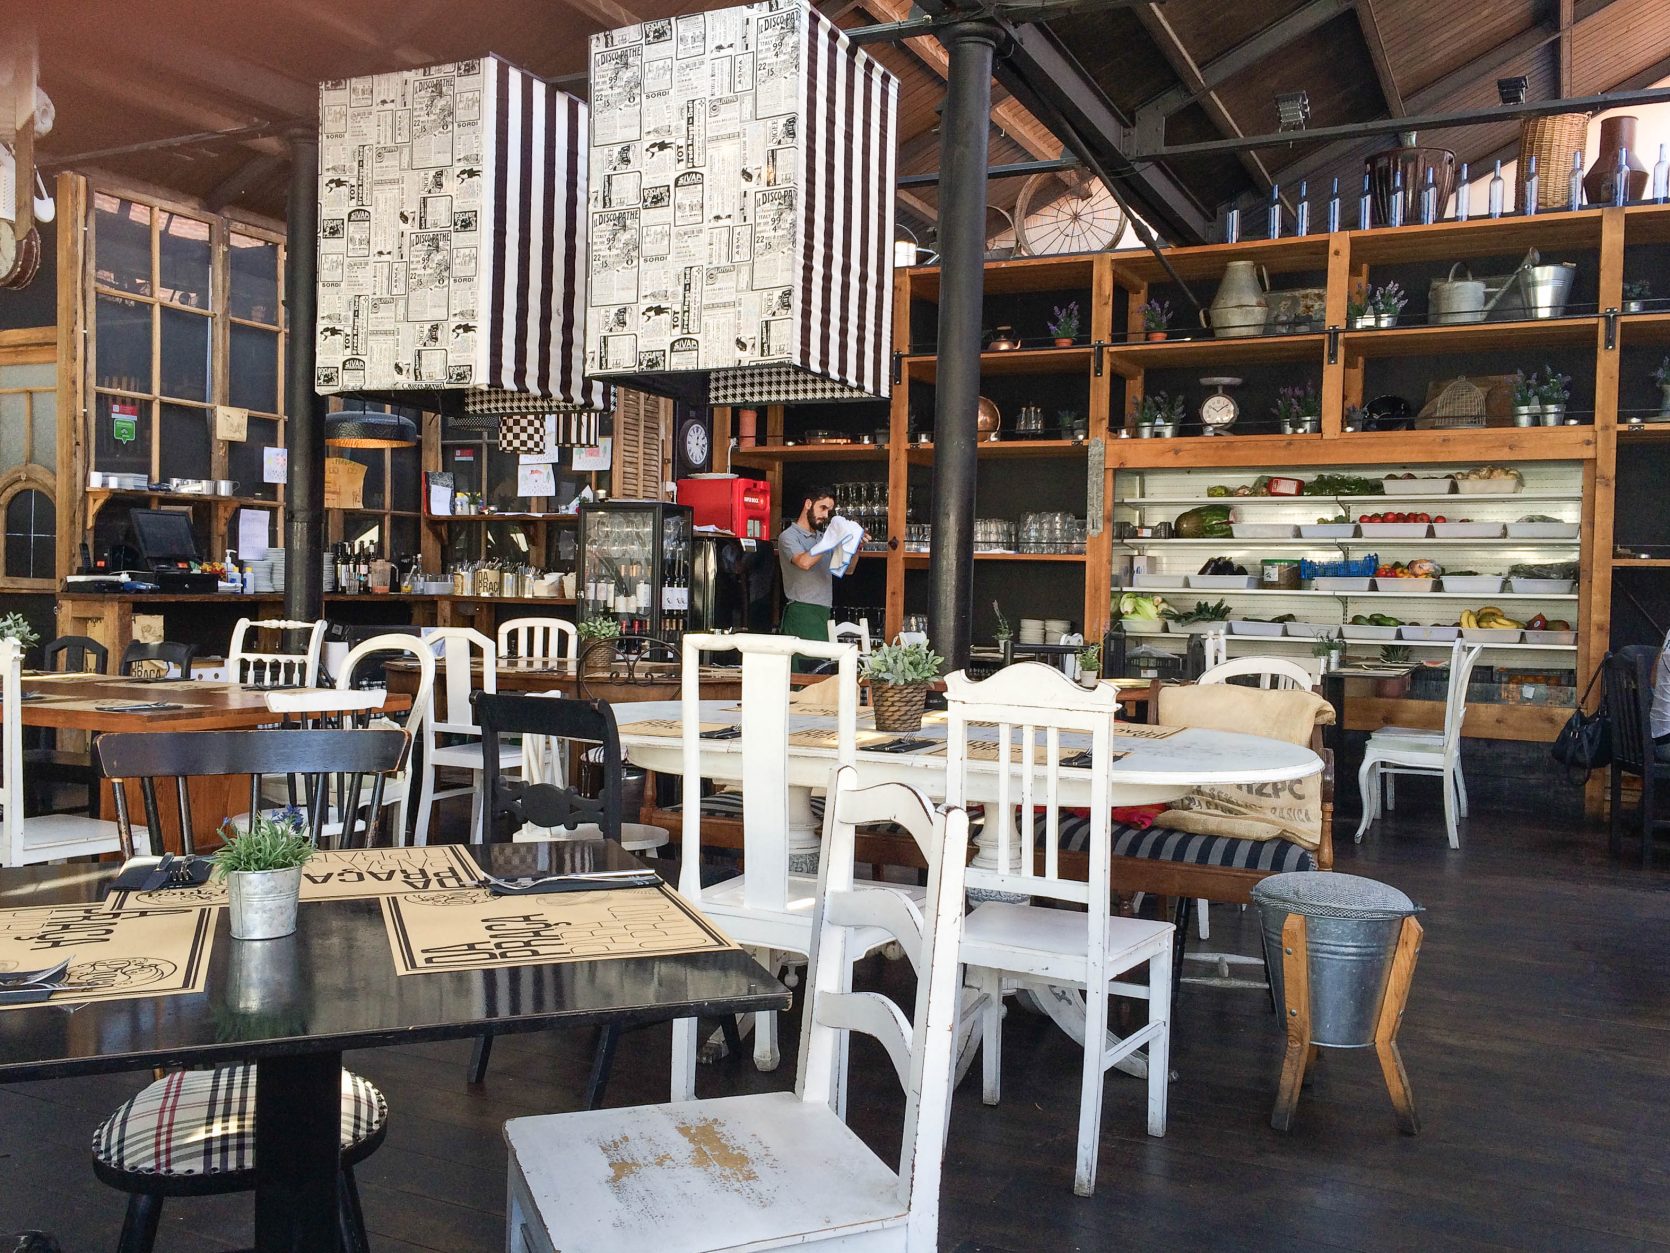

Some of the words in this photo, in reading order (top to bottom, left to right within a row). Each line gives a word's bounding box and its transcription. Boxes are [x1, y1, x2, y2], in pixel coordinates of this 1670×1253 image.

[676, 144, 684, 164] TOT
[302, 866, 463, 885] PRAÇA
[402, 877, 467, 890] DA
[480, 913, 573, 958] PRAÇA
[420, 941, 499, 964] DA
